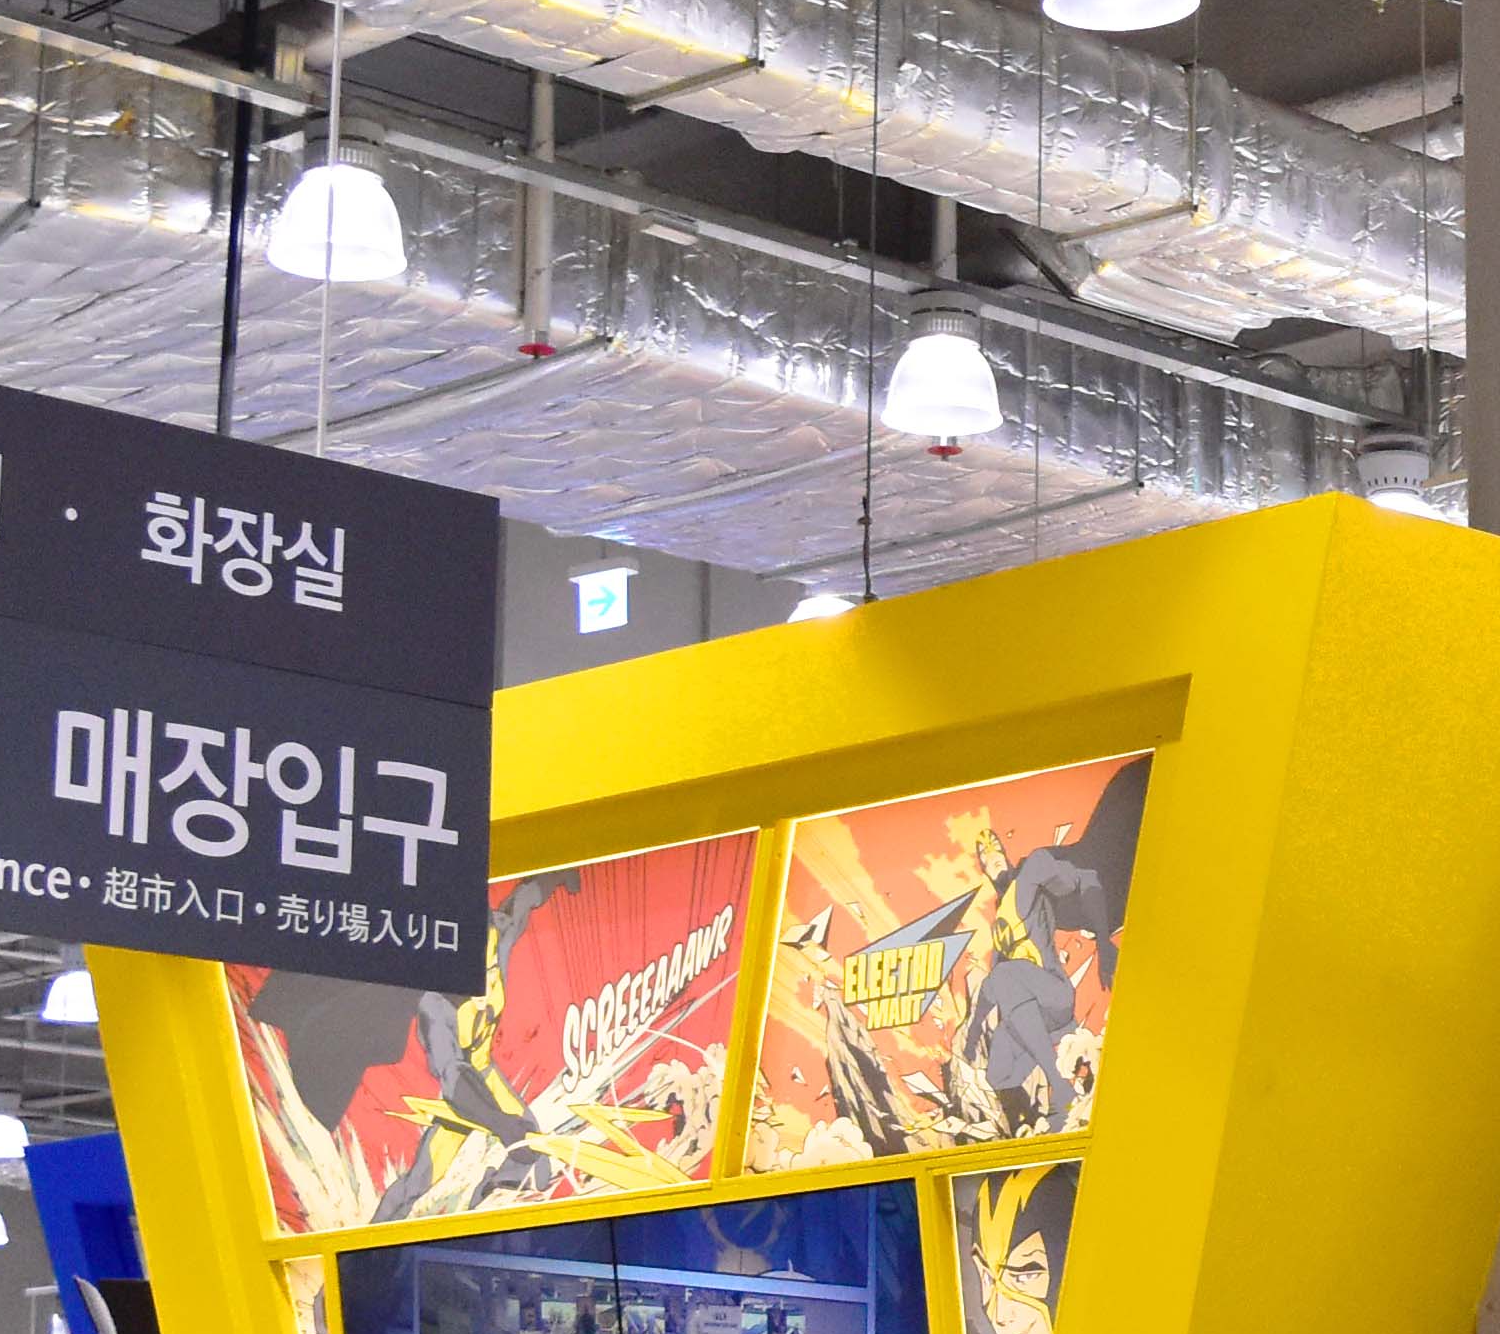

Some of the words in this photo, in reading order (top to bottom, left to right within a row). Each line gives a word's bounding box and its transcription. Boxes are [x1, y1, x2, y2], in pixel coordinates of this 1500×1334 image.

[140, 490, 346, 612] 화장실
[54, 707, 459, 887] 매장입구
[561, 903, 734, 1093] SCREEEAAAWR
[843, 941, 945, 1005] ELECTRO
[866, 993, 925, 1030] MART
